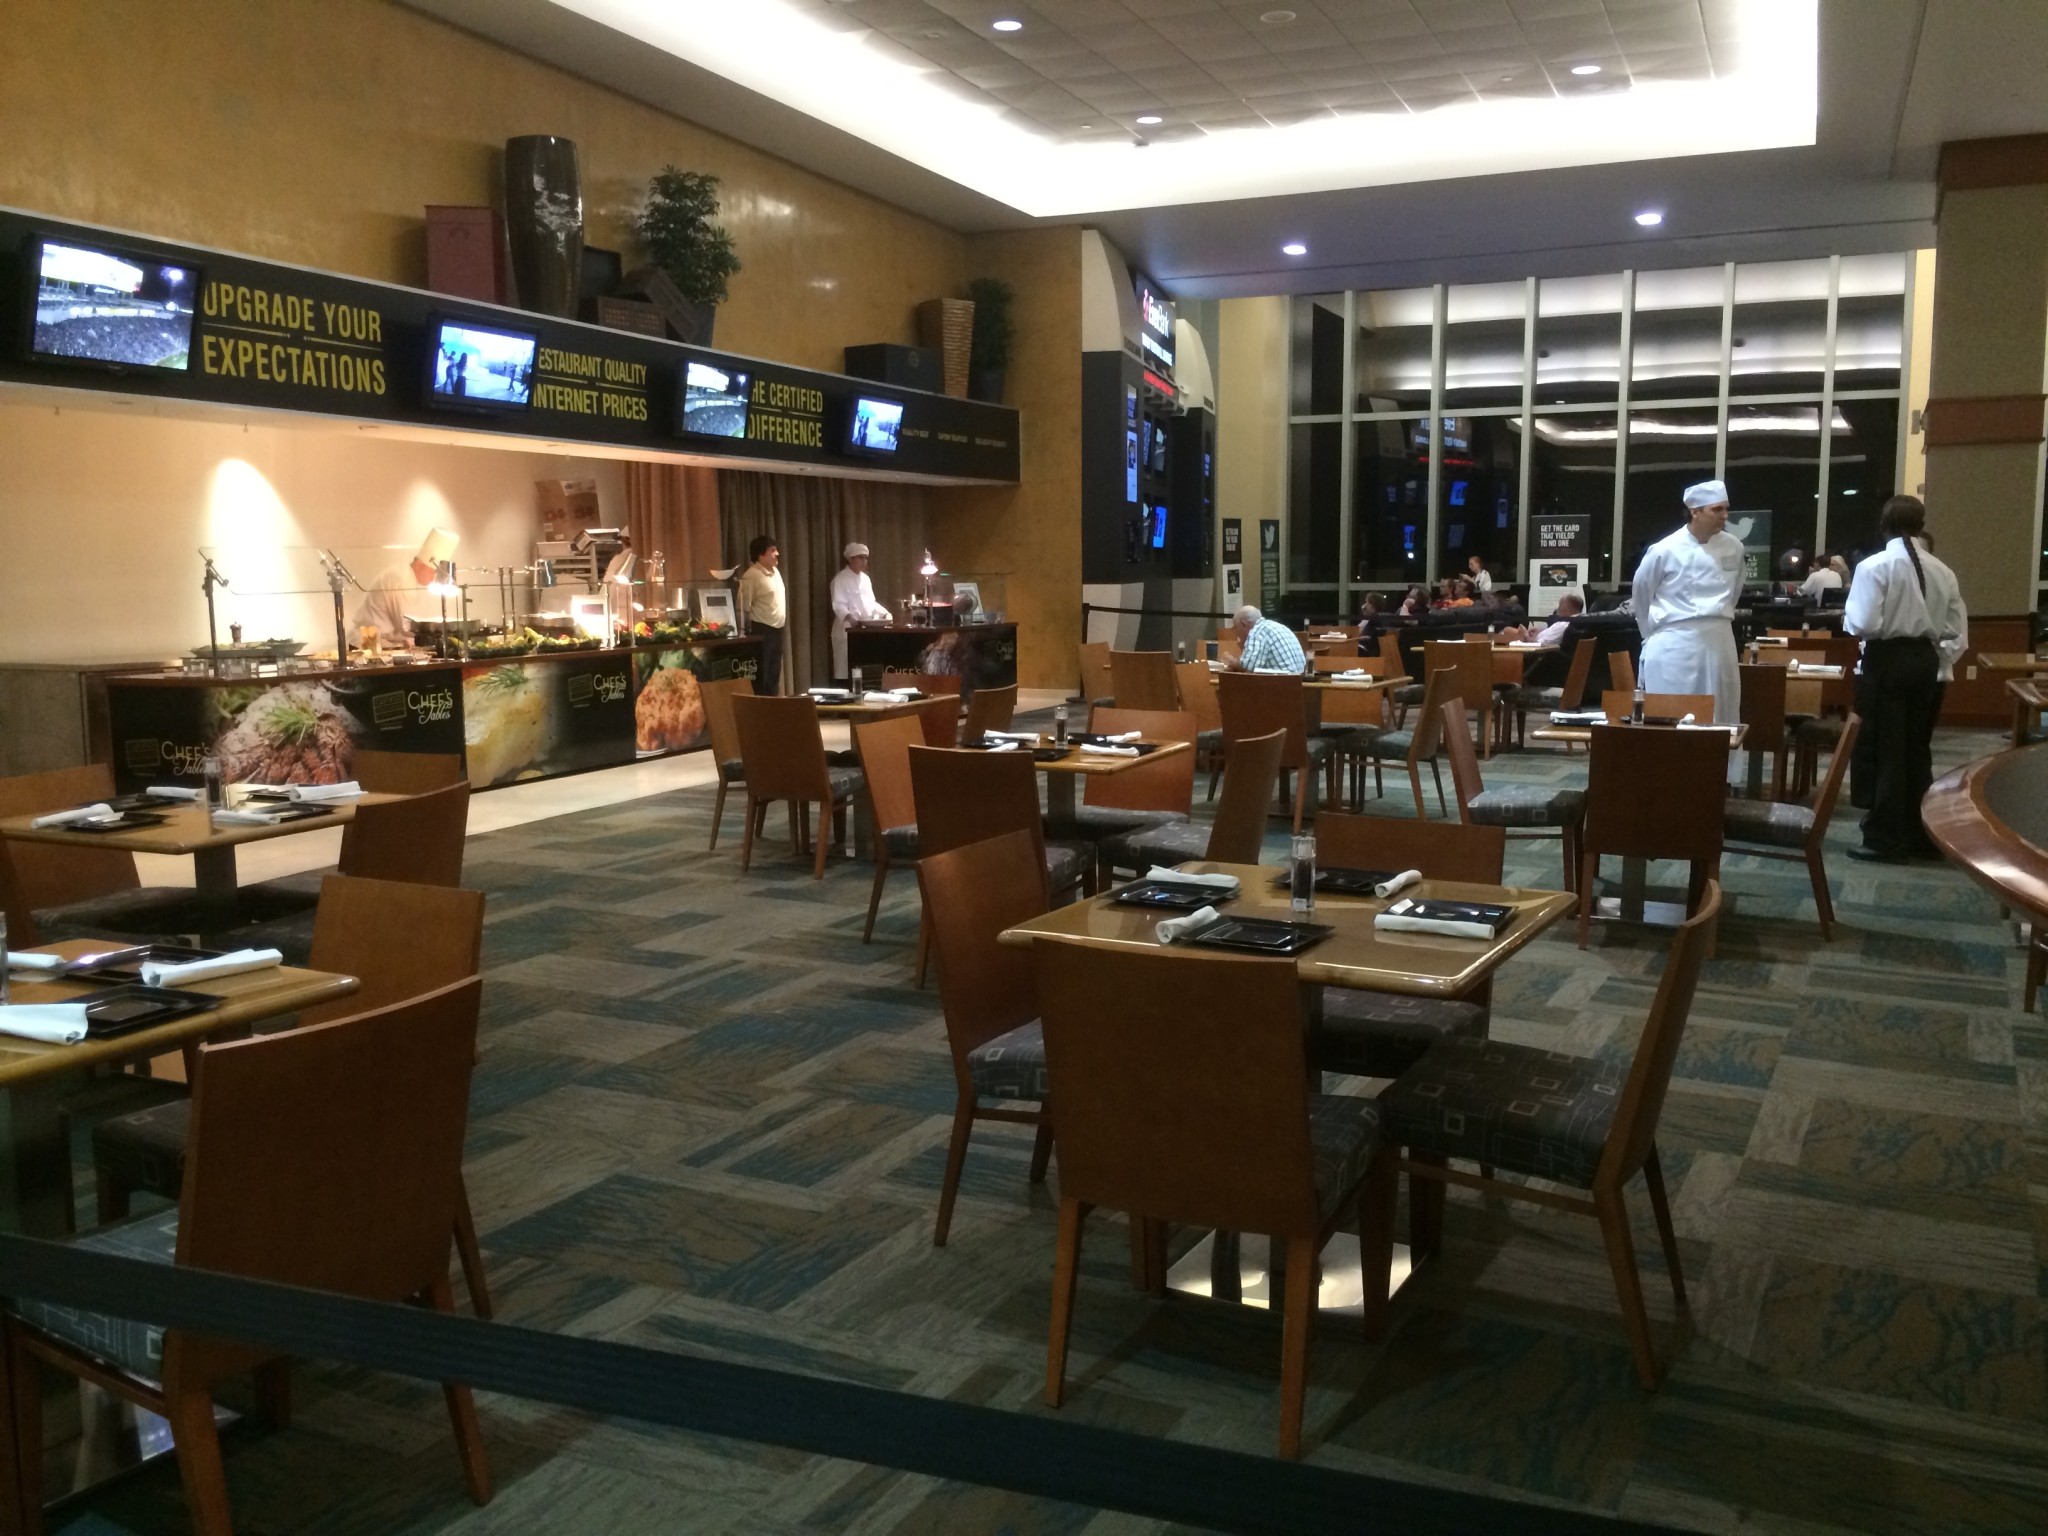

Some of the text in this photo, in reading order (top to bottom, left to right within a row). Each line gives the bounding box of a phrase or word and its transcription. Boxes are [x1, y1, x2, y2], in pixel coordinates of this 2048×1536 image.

[203, 281, 382, 343] UPGRADE YOUR
[202, 335, 386, 396] EXPECTATIONS
[538, 347, 647, 385] ESTAURANT QUALITY
[532, 383, 648, 422] INTERNET PRICES
[751, 380, 823, 413] HE CERTIFIED
[747, 413, 823, 448] DIFFERENCE
[1540, 524, 1580, 532] GET THE CARD
[1540, 532, 1554, 540] THAT
[172, 754, 206, 776] Table
